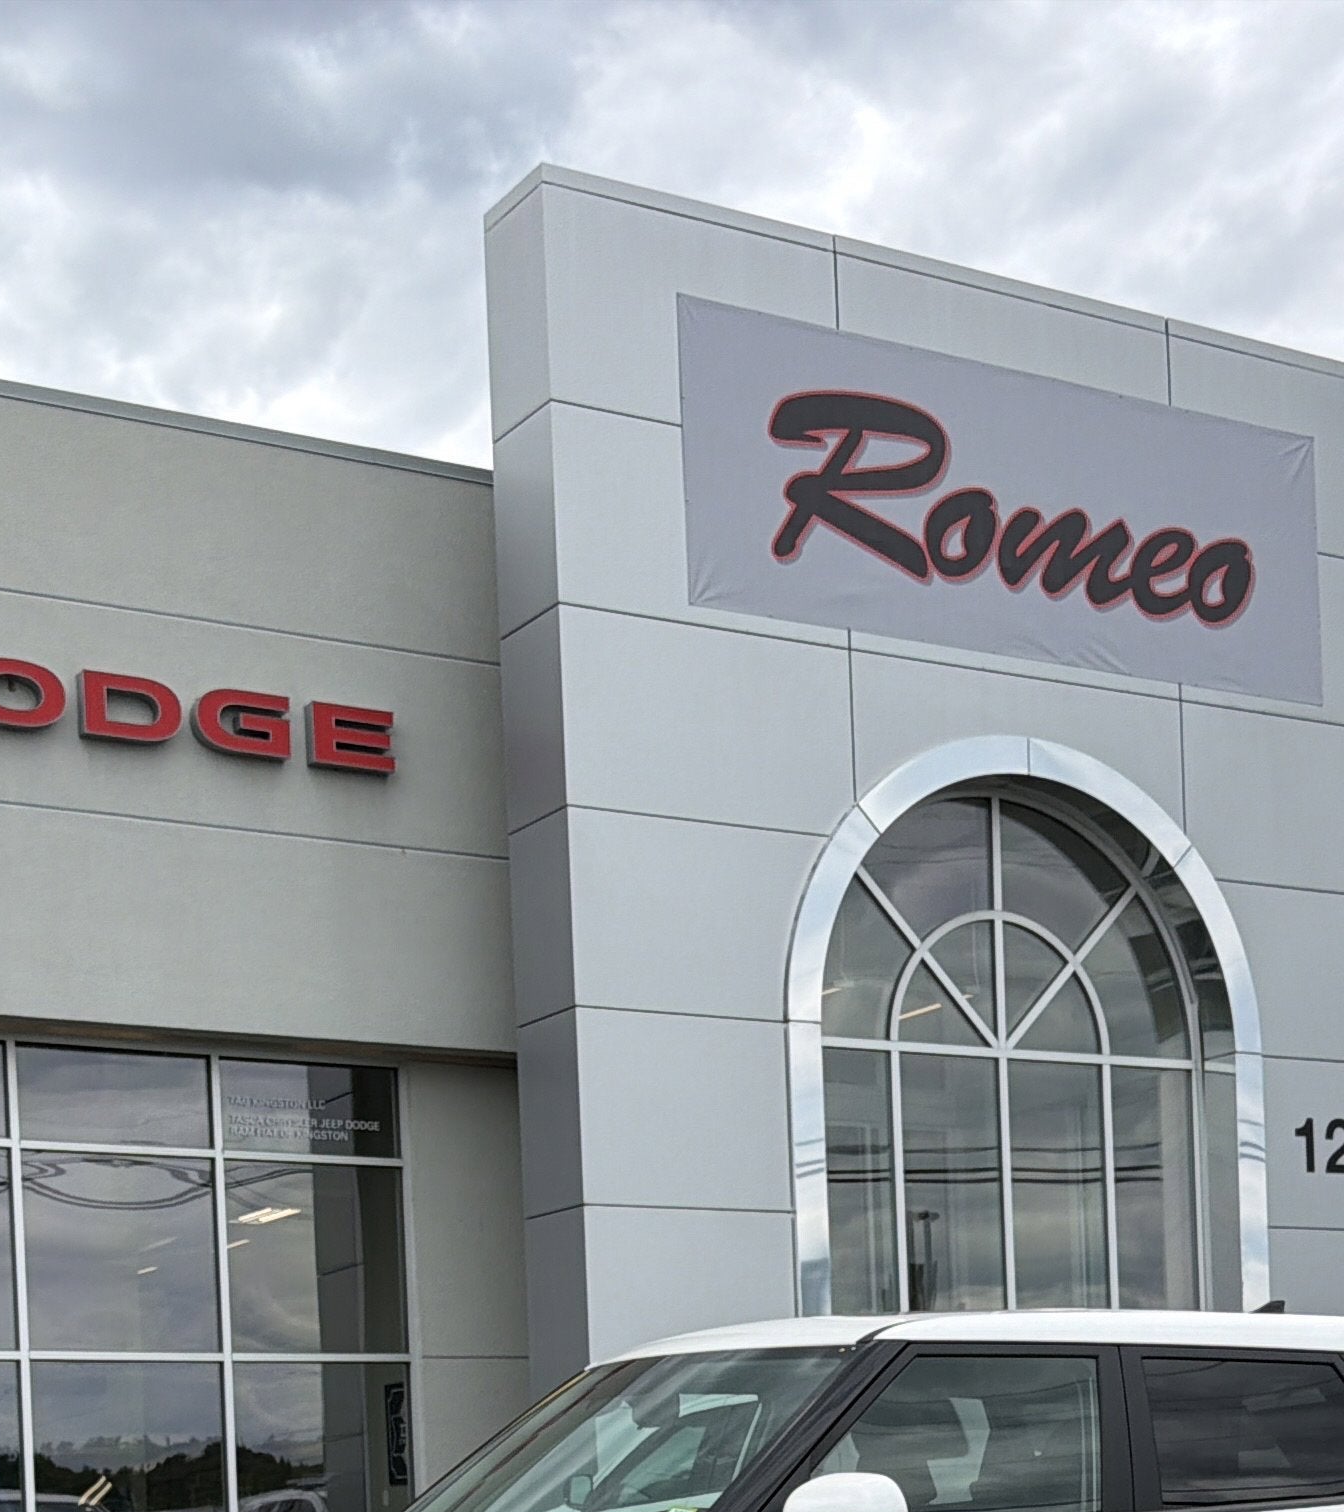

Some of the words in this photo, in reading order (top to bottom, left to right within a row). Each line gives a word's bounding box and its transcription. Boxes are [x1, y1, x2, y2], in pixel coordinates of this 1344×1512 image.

[768, 389, 1256, 629] Romeo
[307, 1100, 326, 1111] LLC
[321, 1119, 344, 1130] JEEP
[345, 1120, 381, 1132] DODGE
